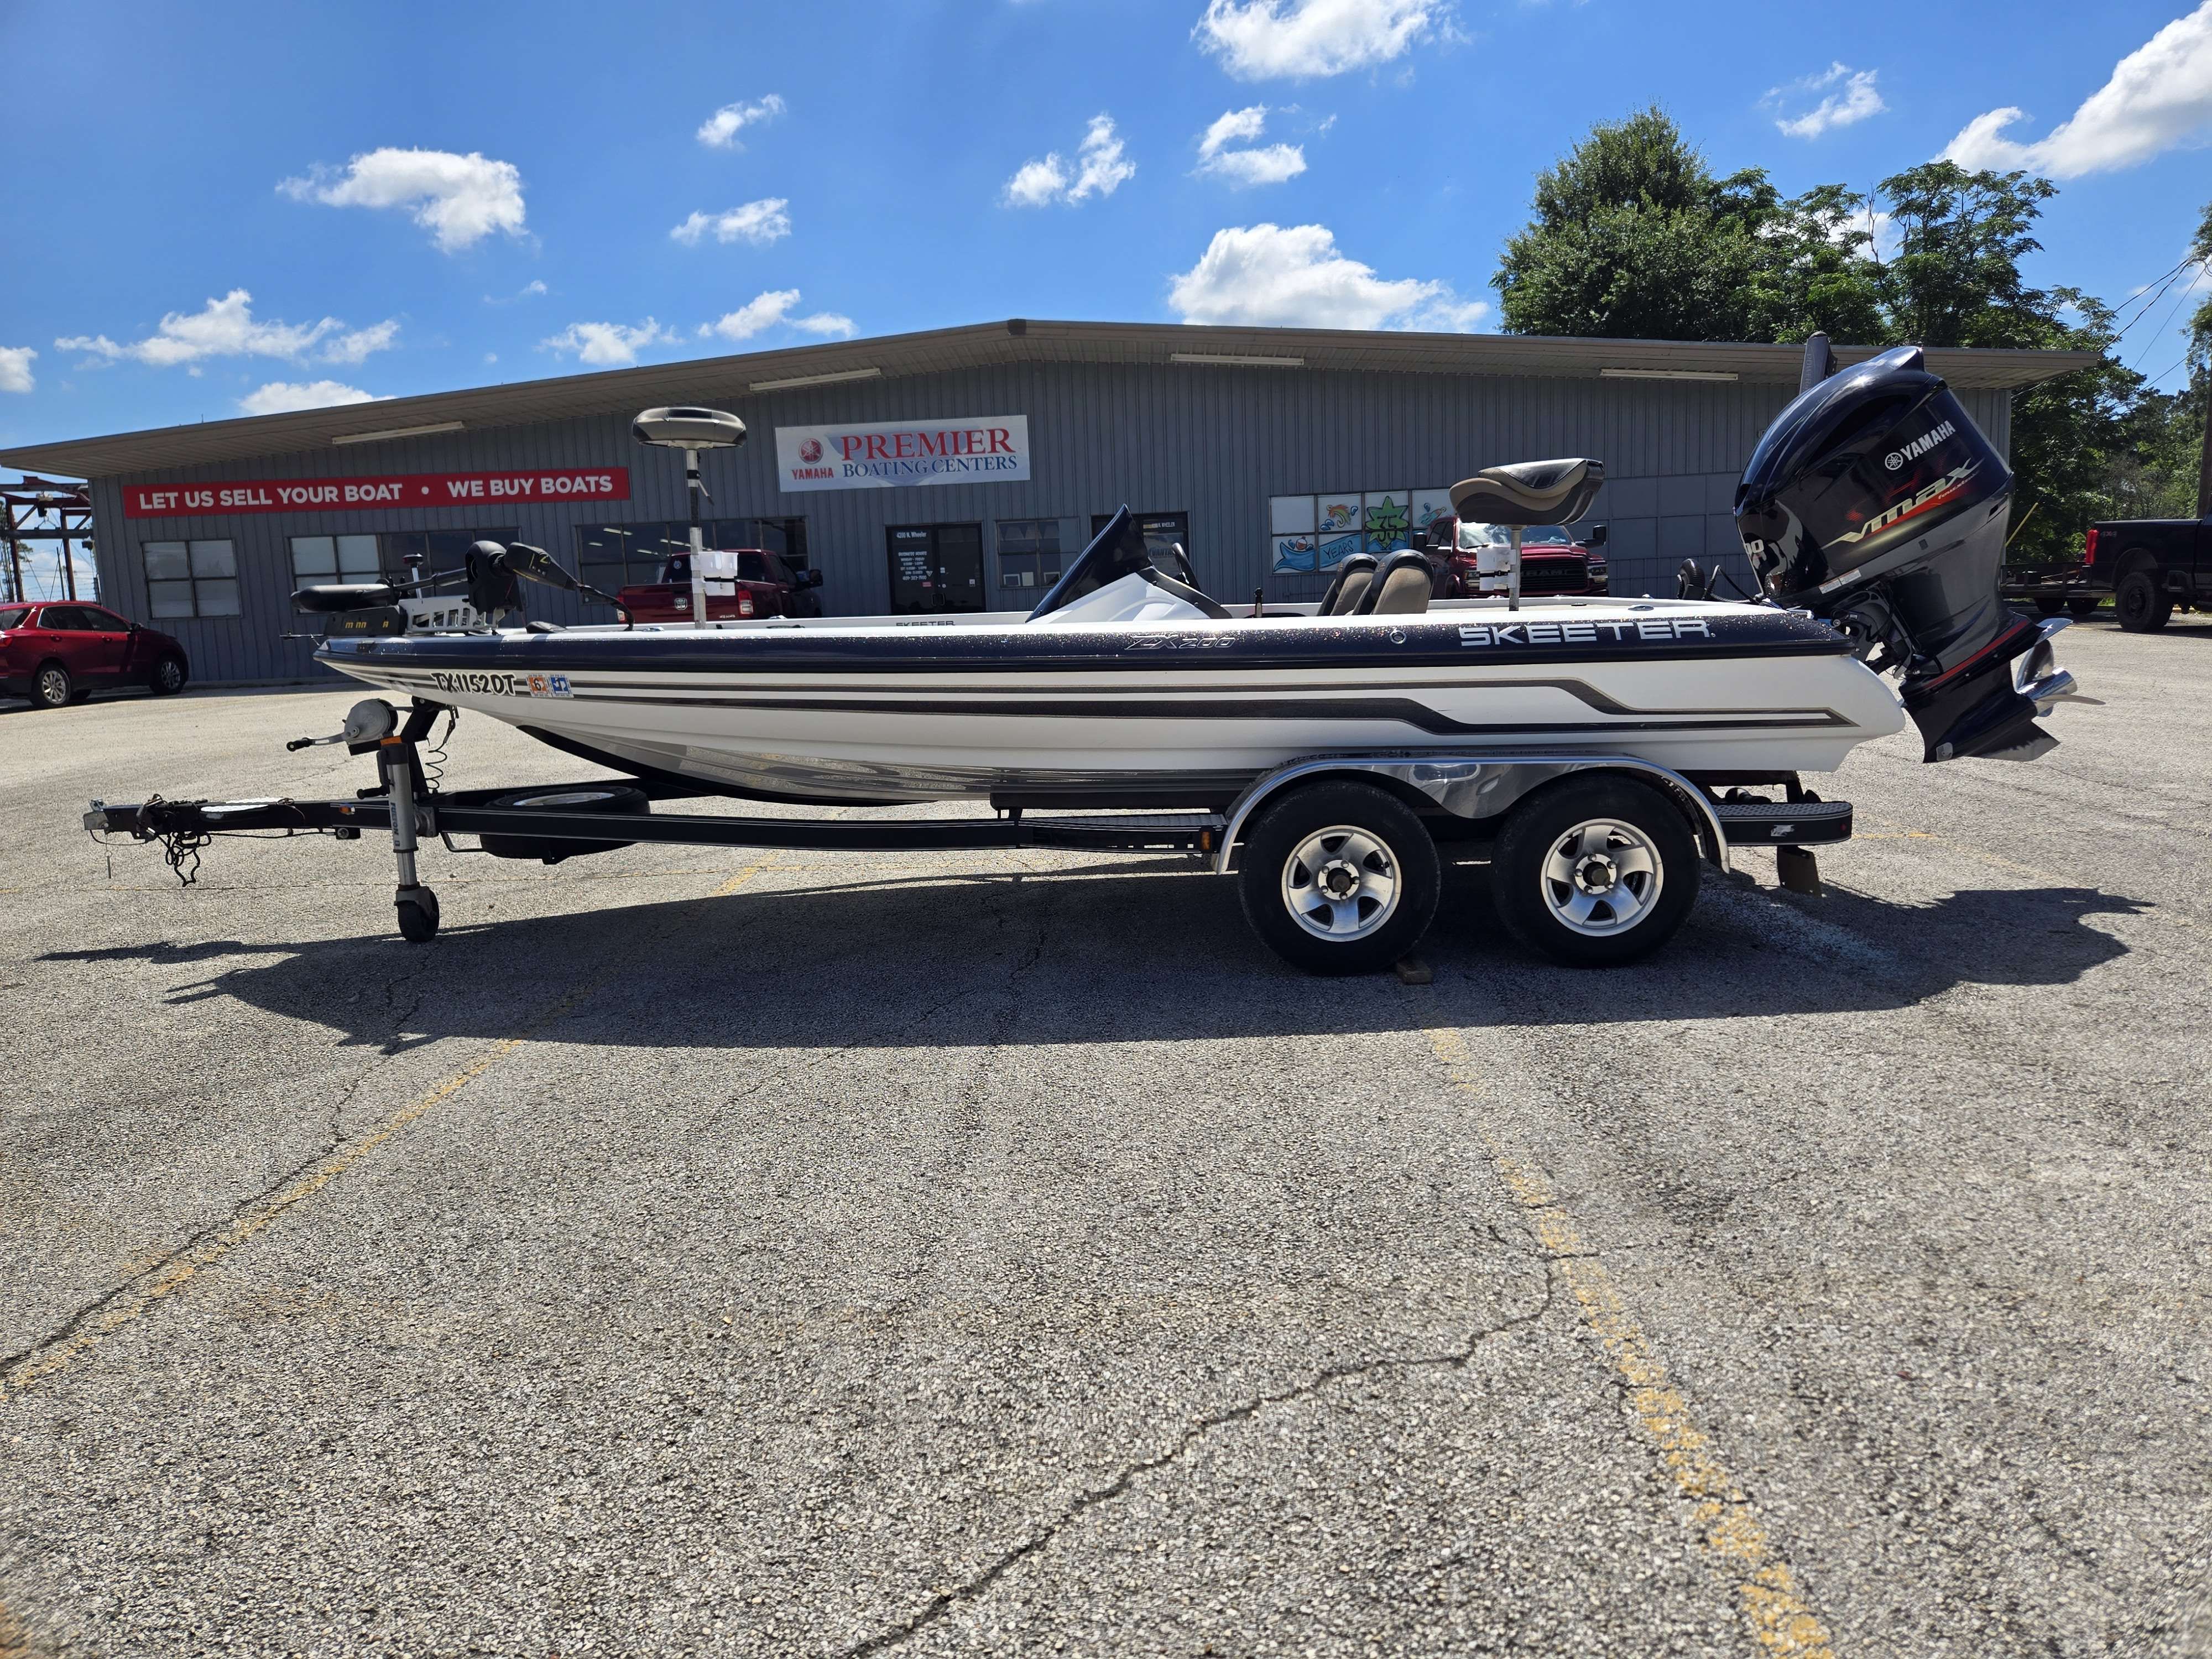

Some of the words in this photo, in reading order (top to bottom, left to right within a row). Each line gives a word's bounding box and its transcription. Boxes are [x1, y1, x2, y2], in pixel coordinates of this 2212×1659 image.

[840, 428, 1016, 461] PREMIER
[1900, 420, 1956, 461] YAMAHA
[792, 467, 834, 480] YAMAHA
[842, 460, 928, 477] BOATING
[932, 455, 1018, 473] CENTERS
[139, 492, 178, 509] LET
[185, 491, 213, 508] US
[220, 488, 272, 507] SELL
[277, 486, 340, 504] YOUR
[345, 483, 403, 502] BOAT
[447, 480, 484, 498] WE
[489, 478, 534, 496] BUY
[540, 476, 613, 494] BOATS
[1377, 515, 1397, 542] 35
[1323, 540, 1354, 559] YEARS
[1458, 620, 1710, 646] SKEETER
[534, 678, 541, 691] 6
